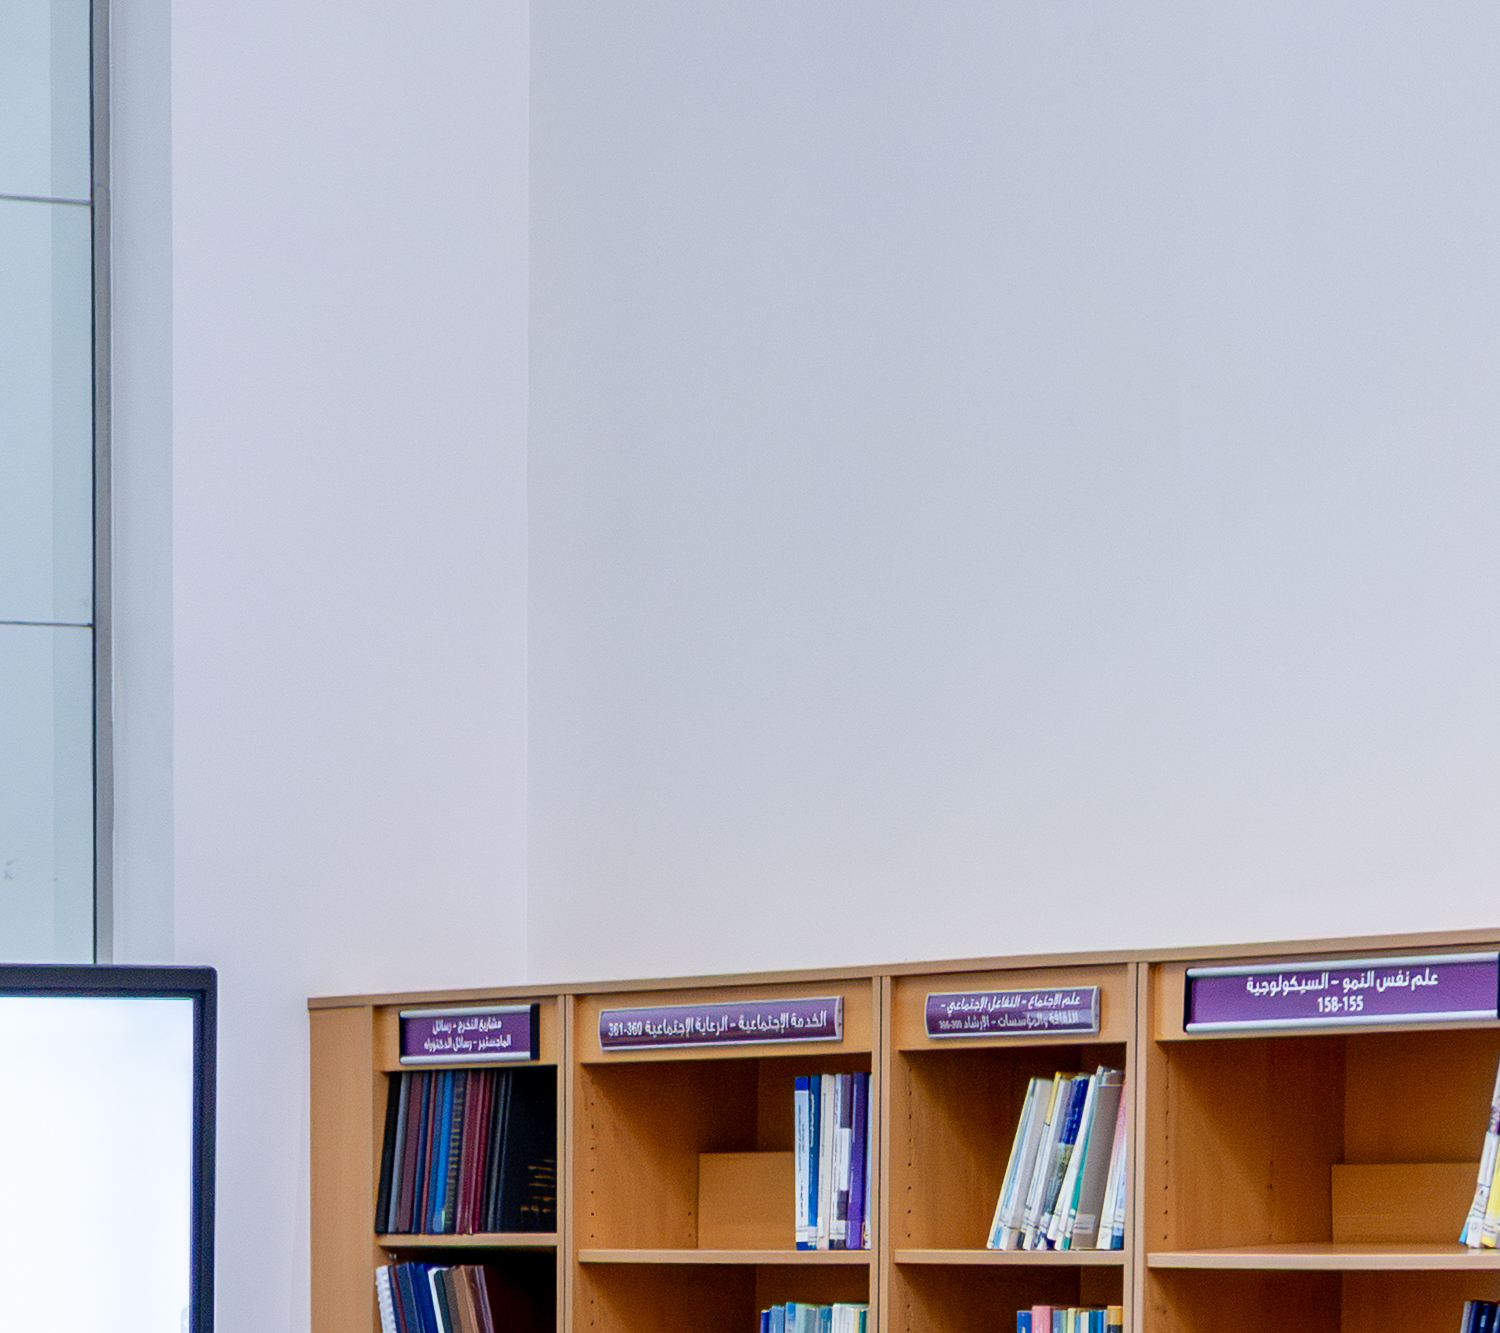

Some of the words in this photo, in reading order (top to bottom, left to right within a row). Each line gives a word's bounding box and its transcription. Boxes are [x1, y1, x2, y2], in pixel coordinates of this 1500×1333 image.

[1246, 973, 1329, 997] السيكولوجية
[1342, 970, 1375, 994] النمو
[1377, 970, 1411, 992] نفس
[1410, 967, 1439, 991] علم
[645, 1019, 693, 1037] الإجتماعية
[695, 1017, 728, 1035] الرعاية
[738, 1013, 789, 1032] الإجتماعية
[800, 1011, 827, 1028] الخدمة
